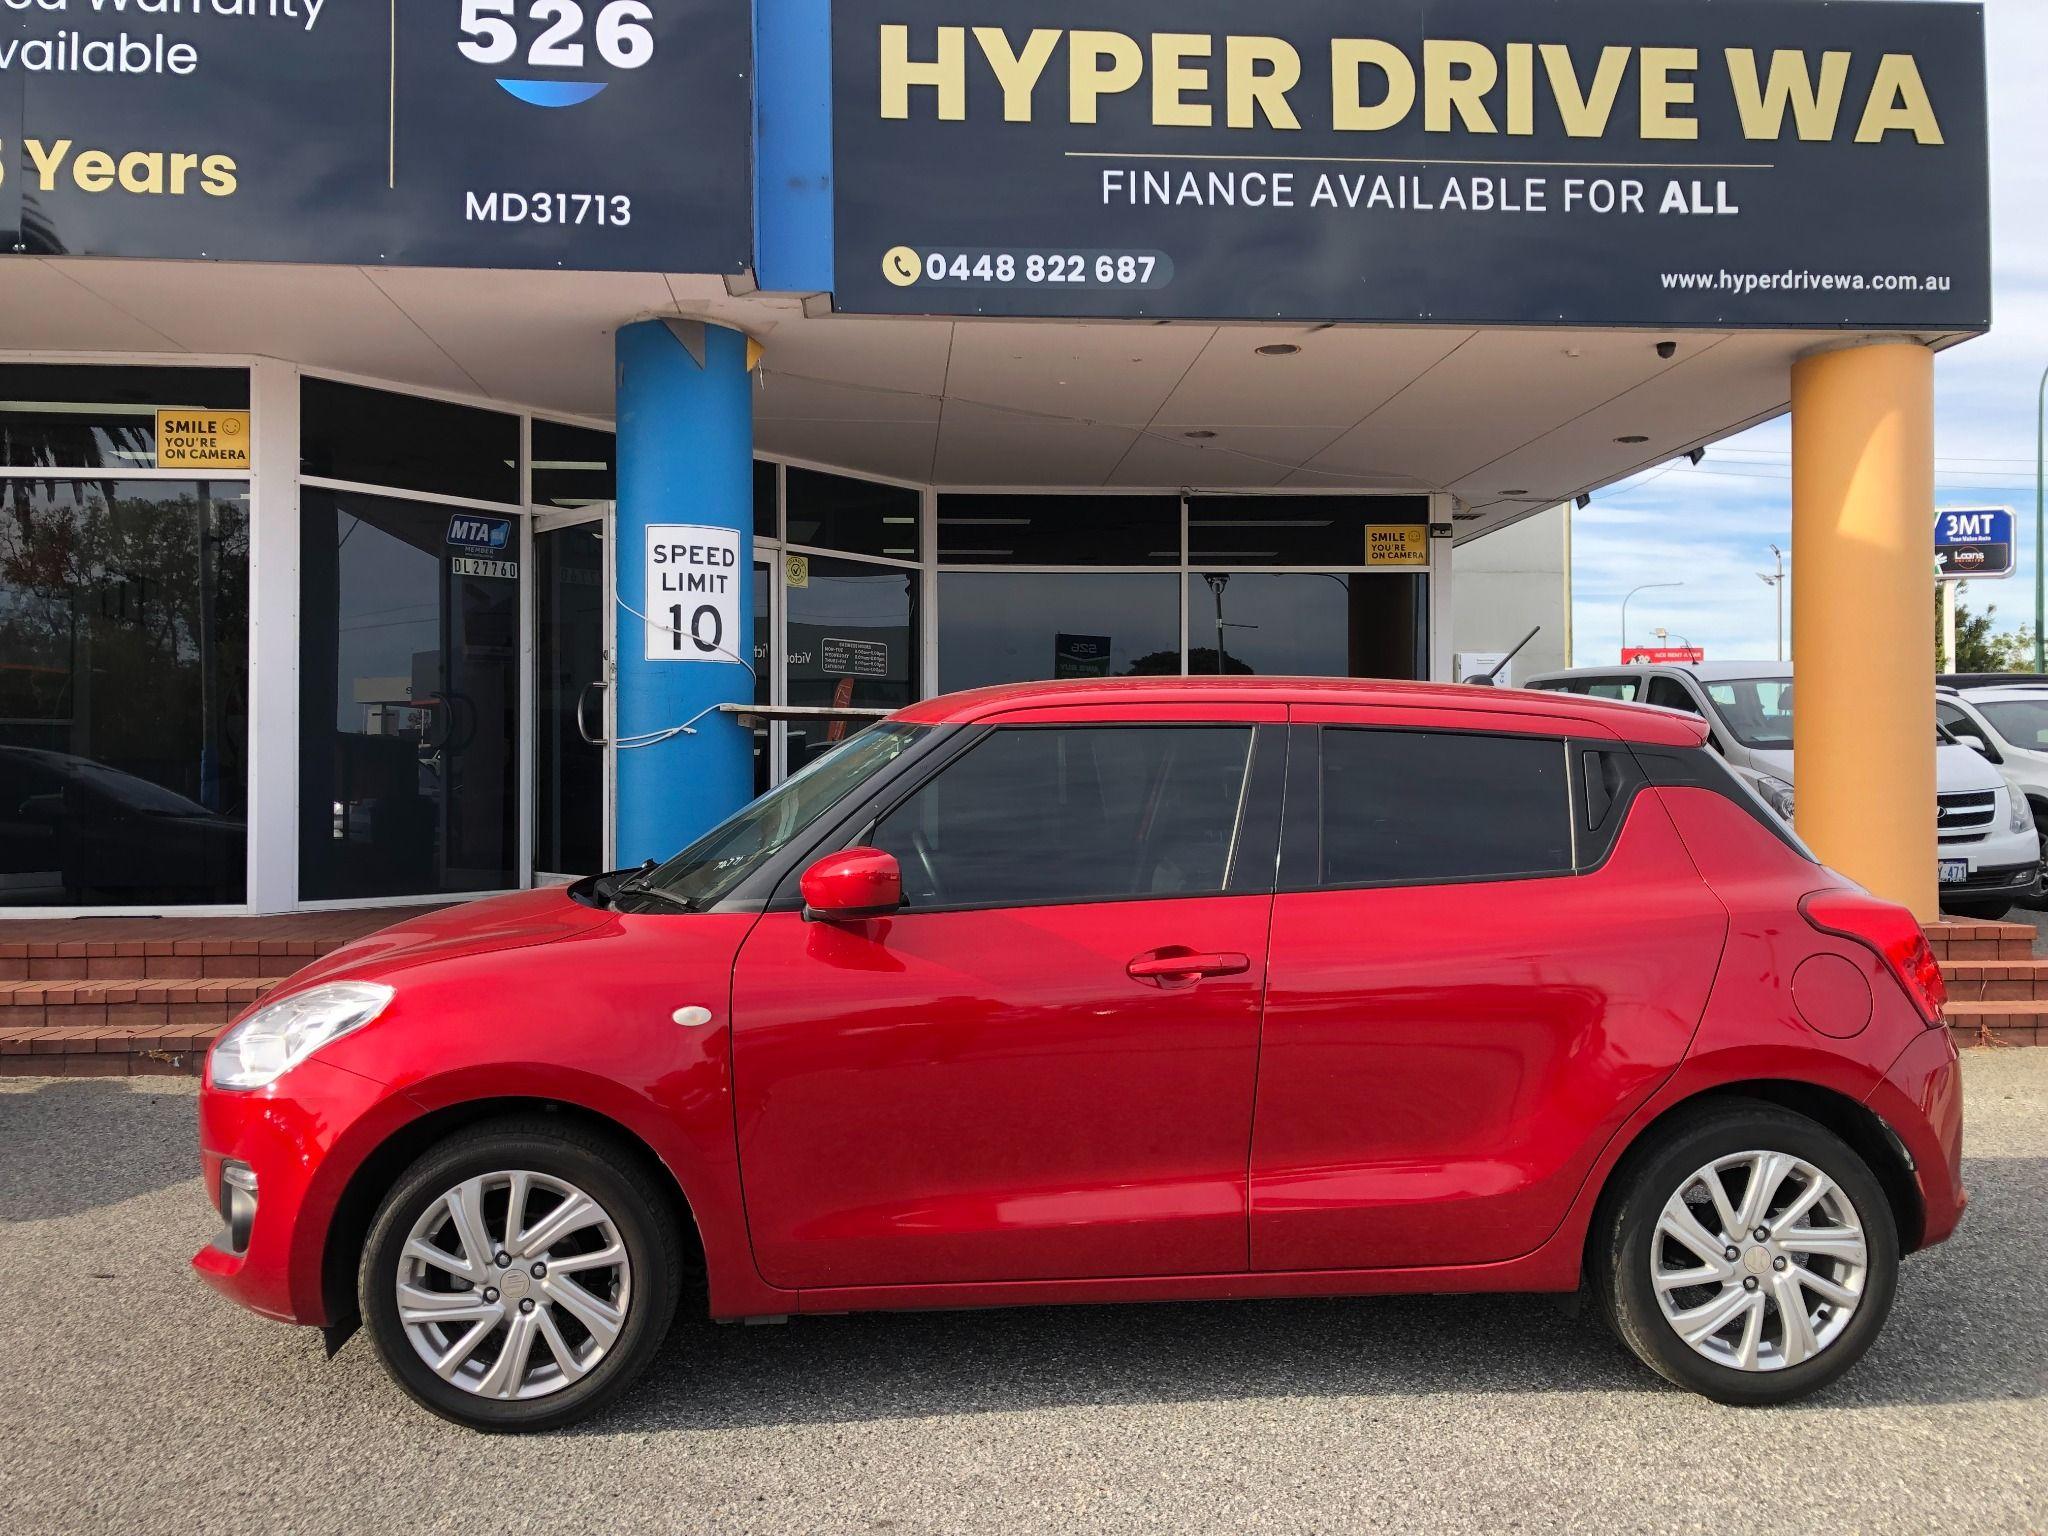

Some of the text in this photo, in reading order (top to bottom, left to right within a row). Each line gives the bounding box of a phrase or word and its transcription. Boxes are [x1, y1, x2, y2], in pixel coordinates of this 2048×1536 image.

[457, 0, 654, 69] 526
[880, 24, 1945, 146] HYPER DRIVE WA
[23, 139, 238, 197] Years
[1102, 170, 1739, 214] FINANCE AVAILABLE FOR ALL
[466, 191, 632, 226] MD31713
[926, 253, 1156, 284] 0448 822 687
[1660, 270, 1951, 294] www.hyperdrivewa.com.au
[165, 420, 217, 434] SMILE
[165, 437, 217, 448] YOU'RE
[165, 449, 246, 460] ON CAMERA
[450, 520, 489, 542] MTA
[1946, 513, 1995, 536] 3MT
[1371, 533, 1406, 542] SMILE
[1371, 544, 1407, 552] YOU'RE
[653, 544, 735, 567] SPEED
[1387, 551, 1424, 559] CAMERA
[1954, 551, 1984, 560] Loans
[662, 572, 728, 594] LIMIT
[669, 604, 722, 652] 10
